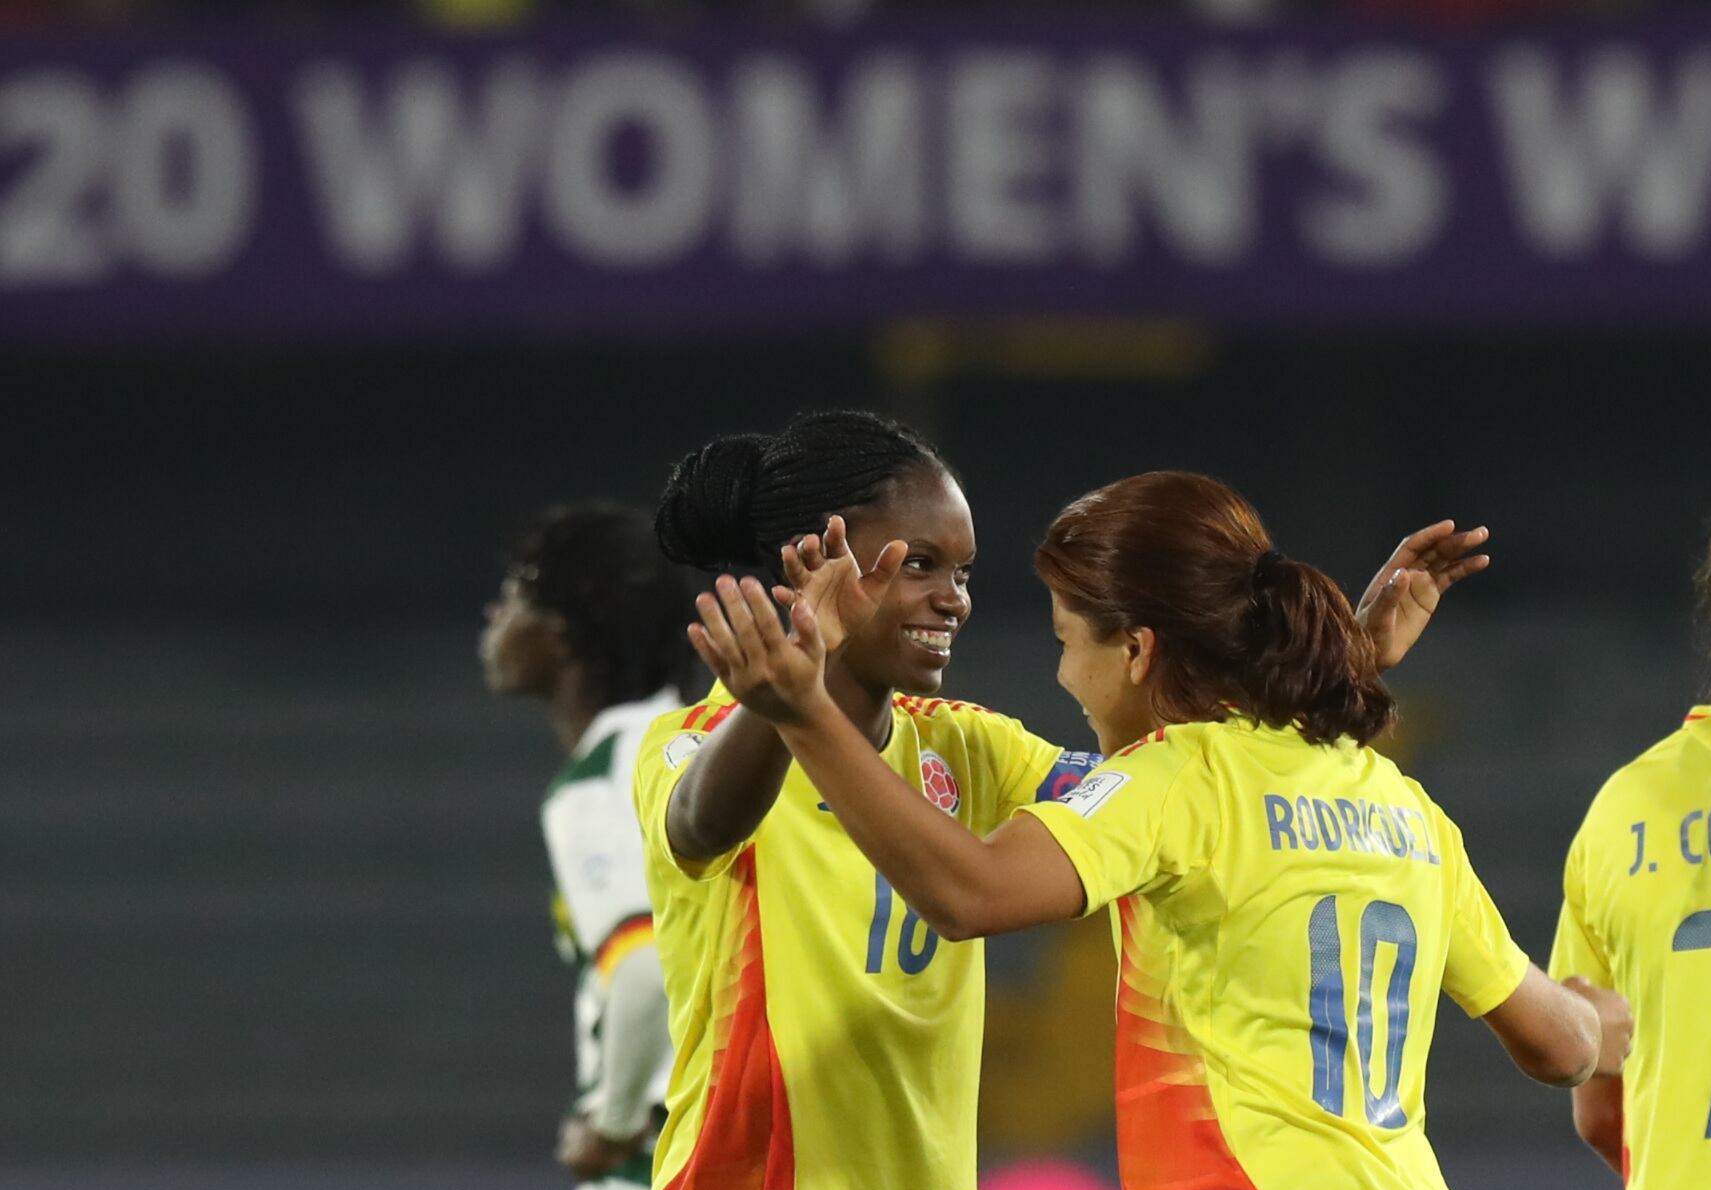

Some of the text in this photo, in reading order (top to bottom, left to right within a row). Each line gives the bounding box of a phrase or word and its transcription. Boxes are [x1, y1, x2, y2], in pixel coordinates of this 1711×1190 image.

[296, 46, 1448, 270] WOMEN'S
[1629, 821, 1657, 876] J.
[1308, 895, 1418, 1129] 10
